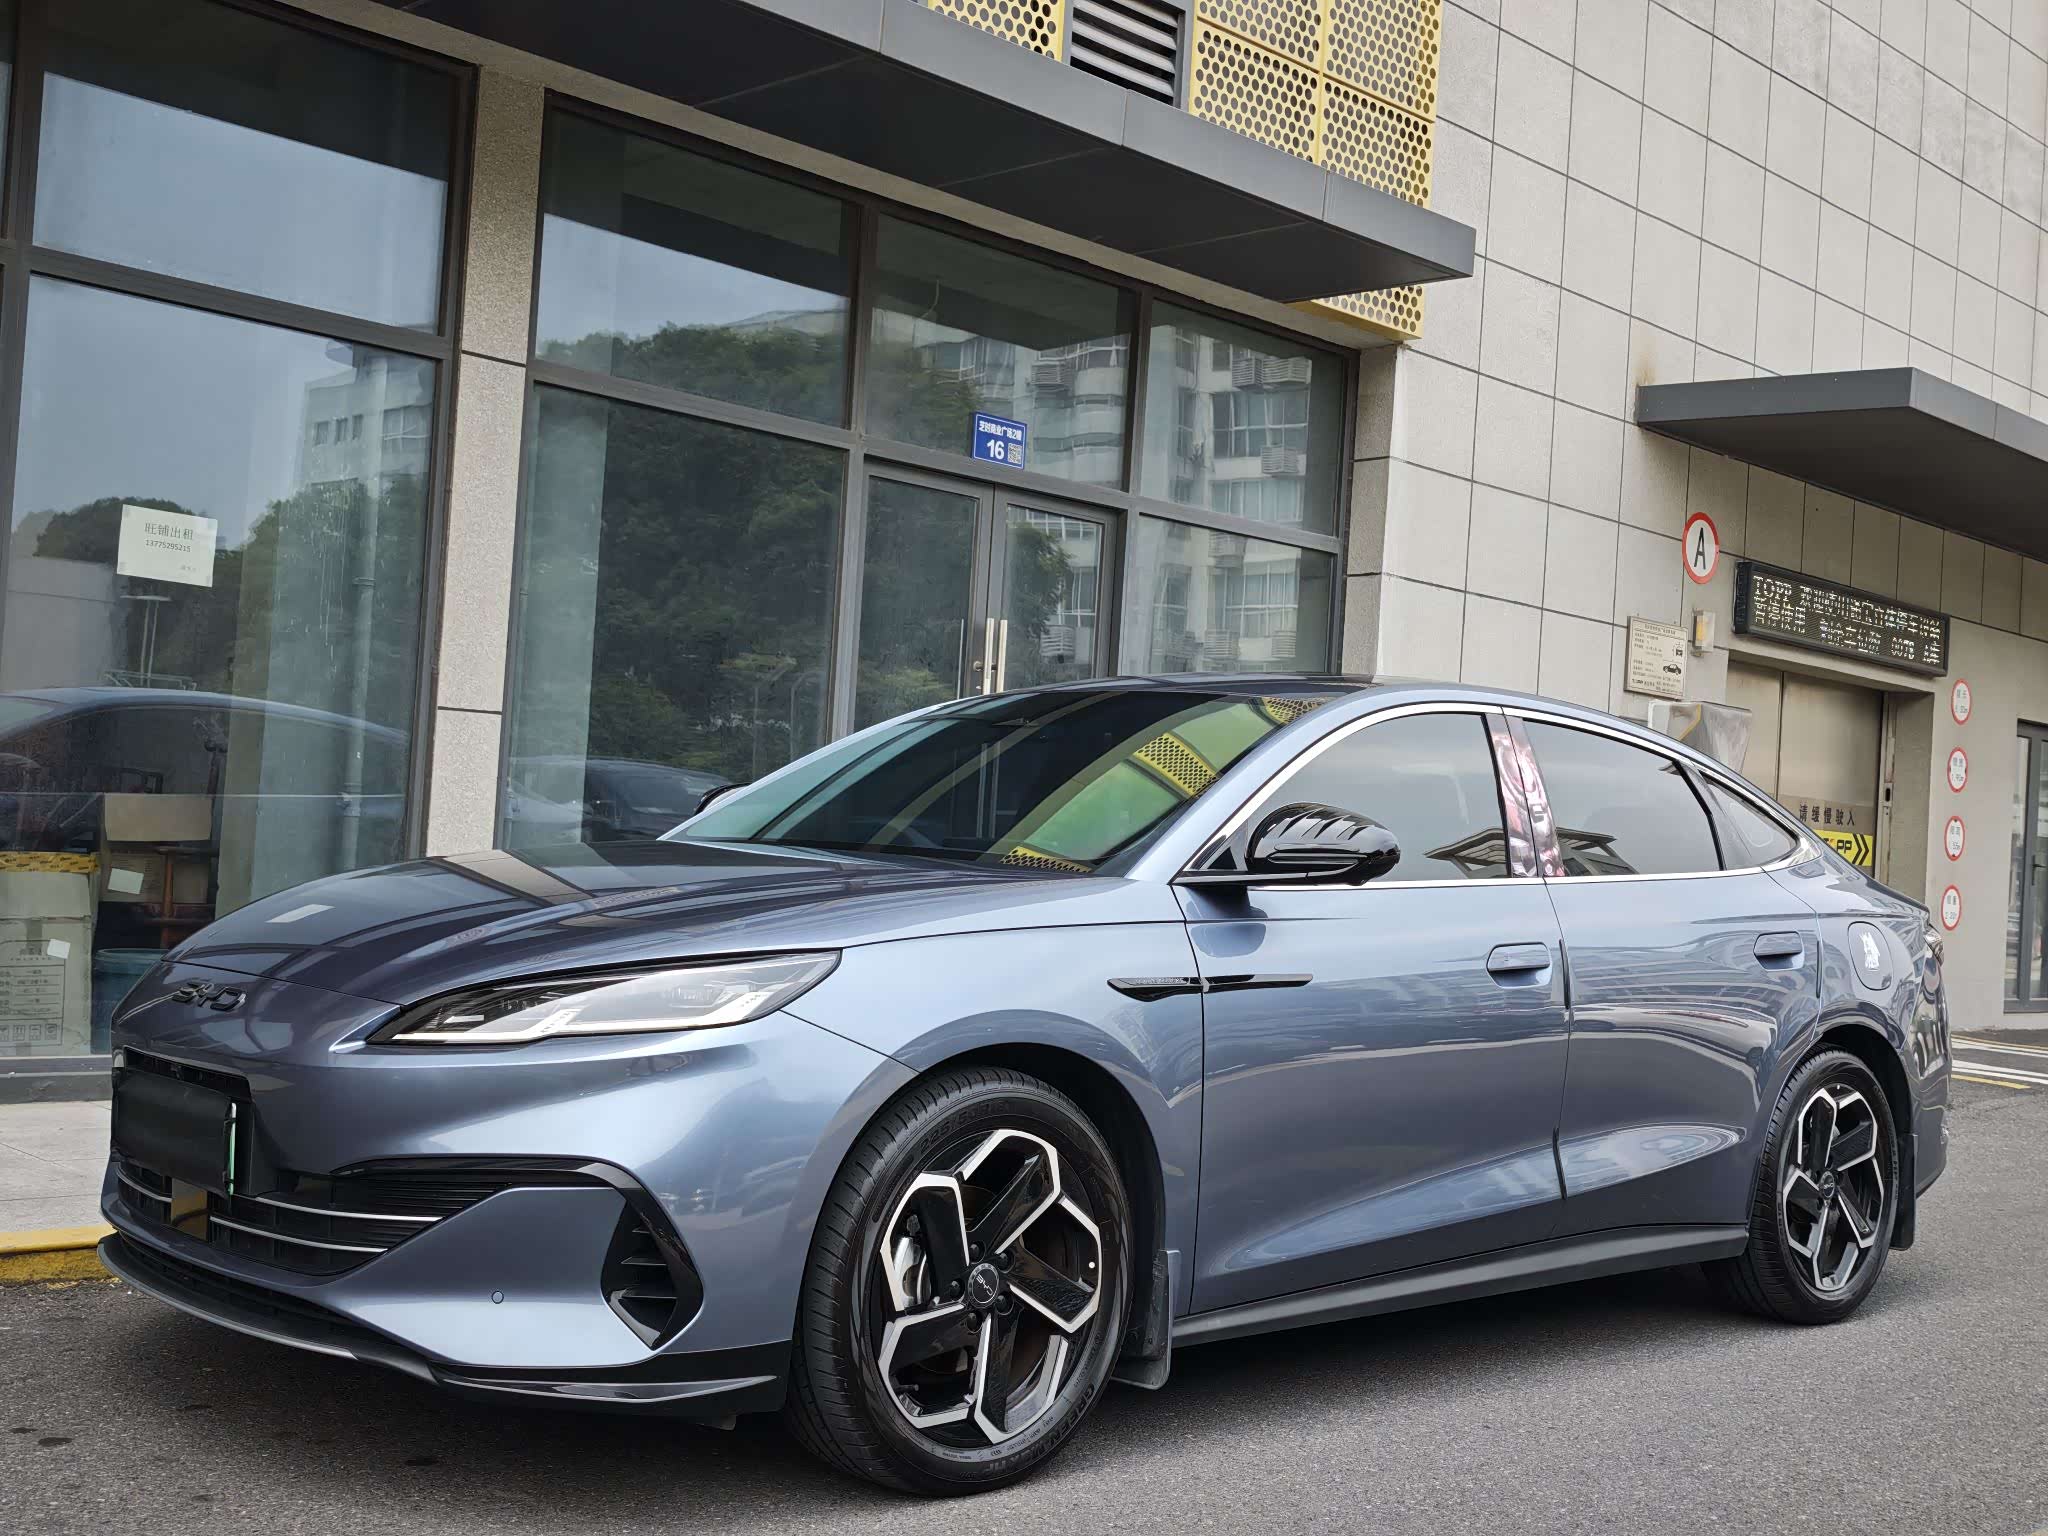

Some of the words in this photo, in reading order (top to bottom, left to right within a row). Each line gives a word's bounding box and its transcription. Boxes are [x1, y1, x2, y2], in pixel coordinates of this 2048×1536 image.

[987, 439, 1004, 460] 16
[144, 522, 194, 541] 旺铺出租
[145, 539, 191, 553] 13775295215
[1693, 527, 1706, 570] A
[1800, 804, 1855, 827] 请缓慢驶入
[172, 981, 247, 1012] BYD
[976, 1274, 994, 1296] BYD
